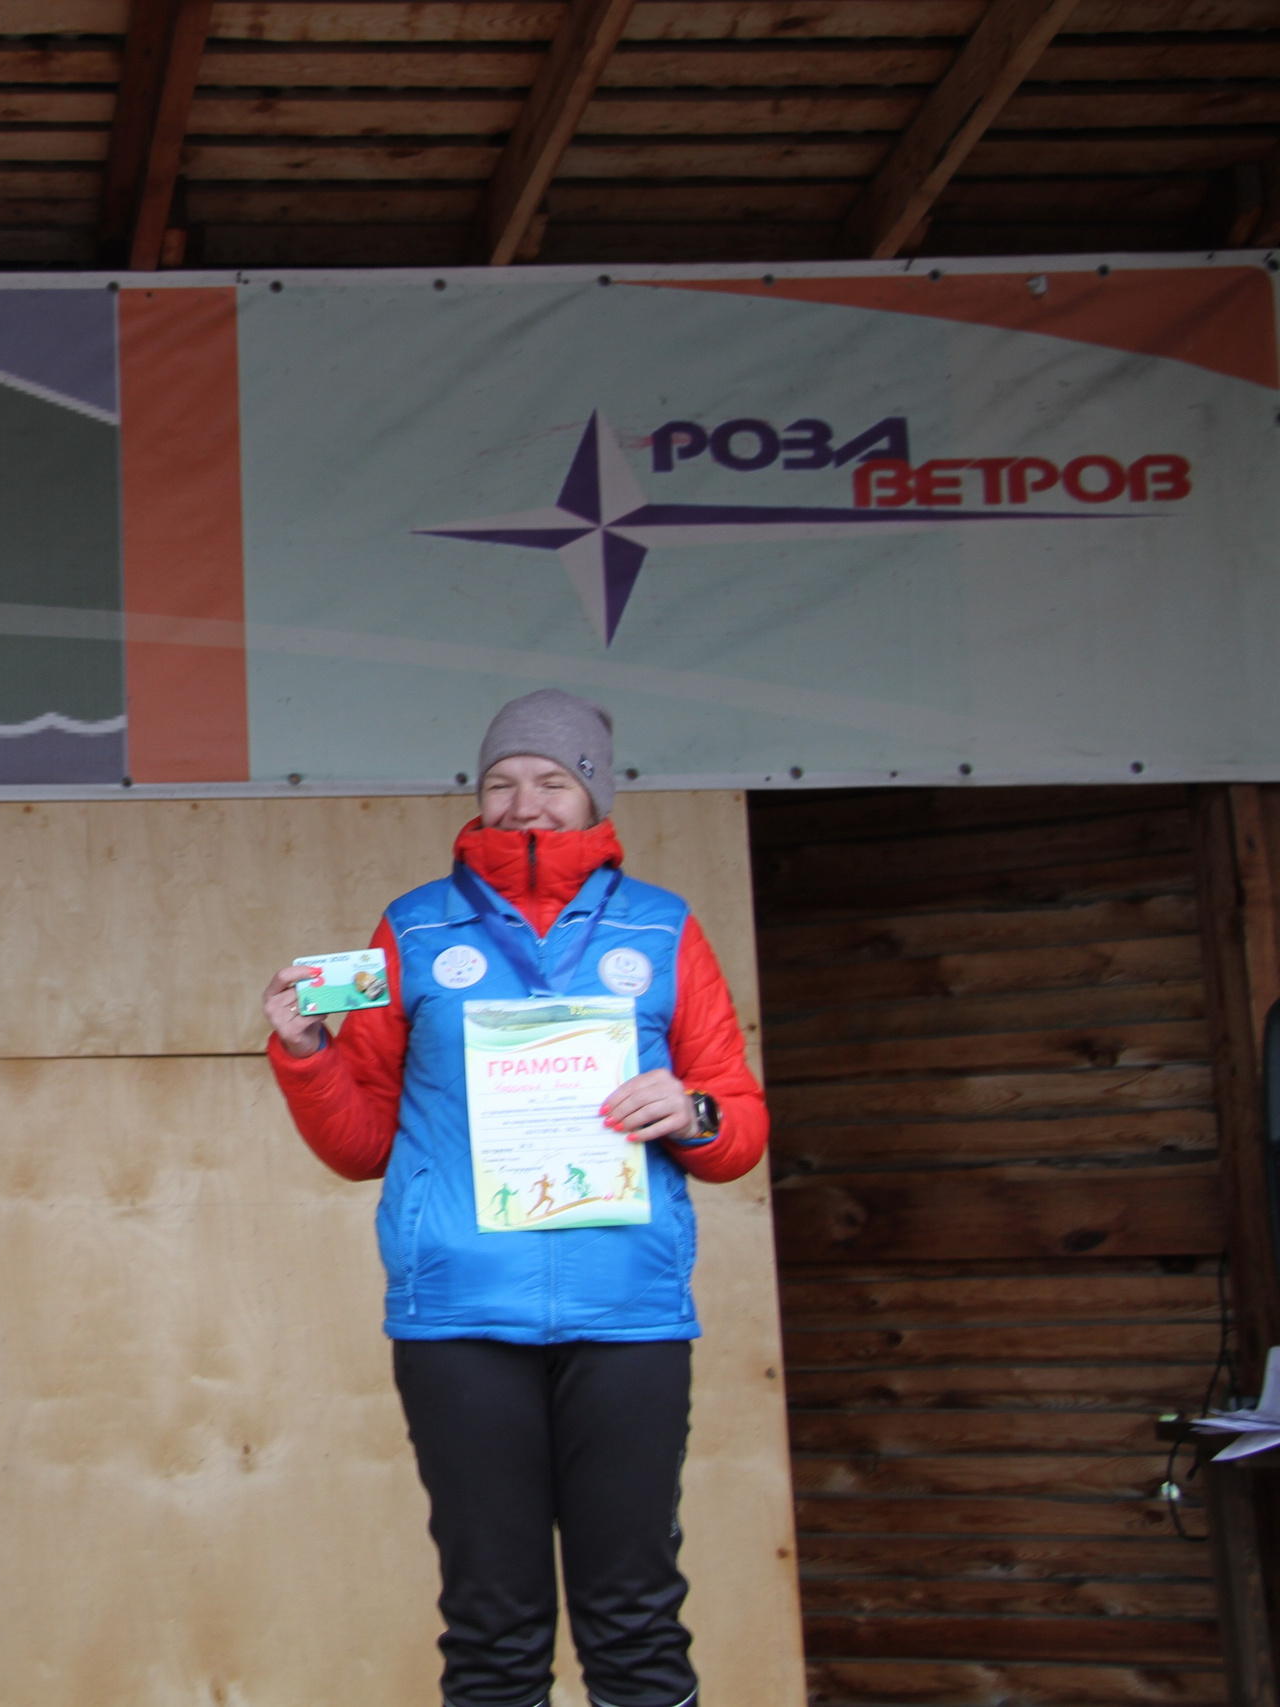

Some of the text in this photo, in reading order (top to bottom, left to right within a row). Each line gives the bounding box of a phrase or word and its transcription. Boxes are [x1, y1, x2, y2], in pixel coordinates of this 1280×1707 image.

[651, 416, 910, 473] РОЗА
[852, 455, 1192, 508] ВЕТРОВ
[486, 1056, 599, 1078] ГРАМОТА
